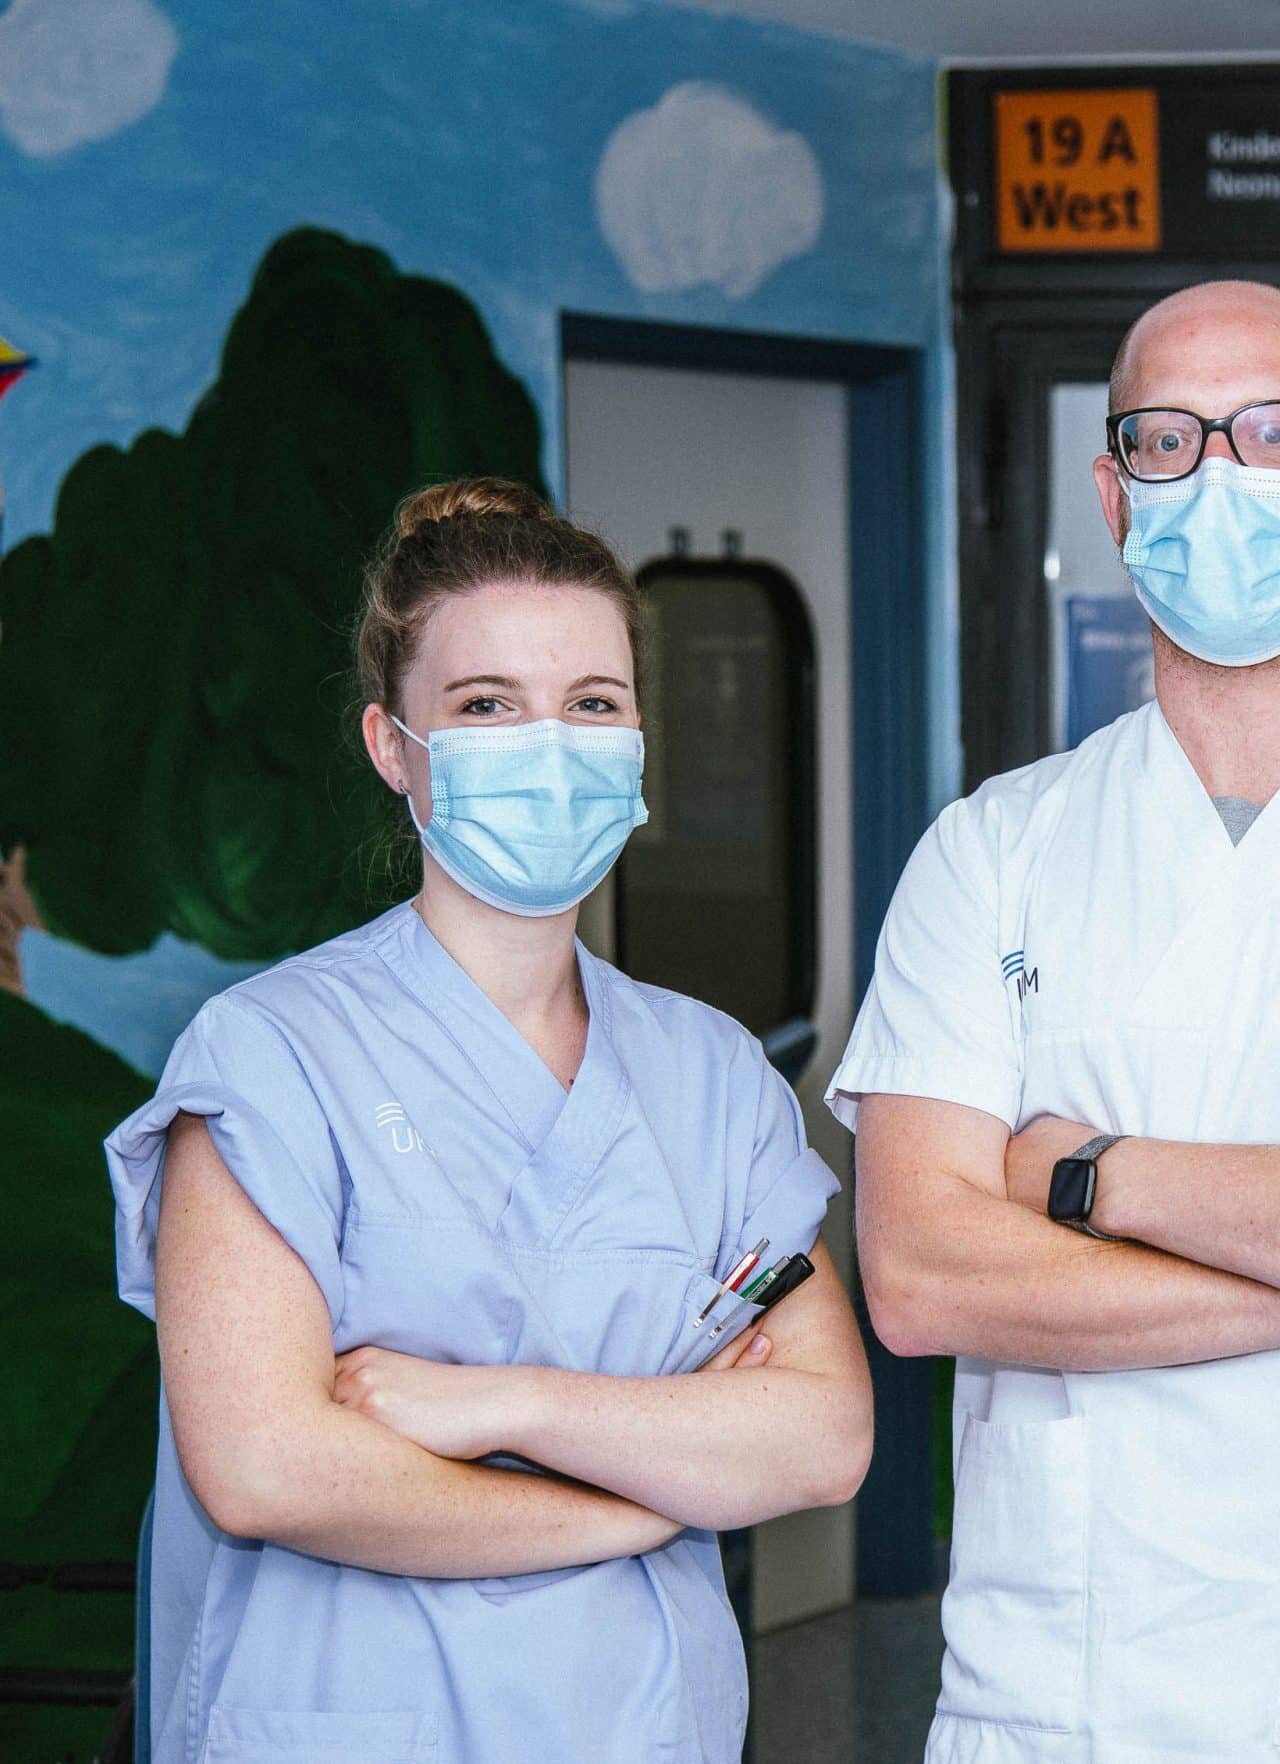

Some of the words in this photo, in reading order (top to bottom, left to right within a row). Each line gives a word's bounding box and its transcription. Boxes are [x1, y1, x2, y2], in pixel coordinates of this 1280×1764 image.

[1024, 116, 1083, 166] 19
[1099, 117, 1137, 165] A
[1012, 182, 1140, 231] West
